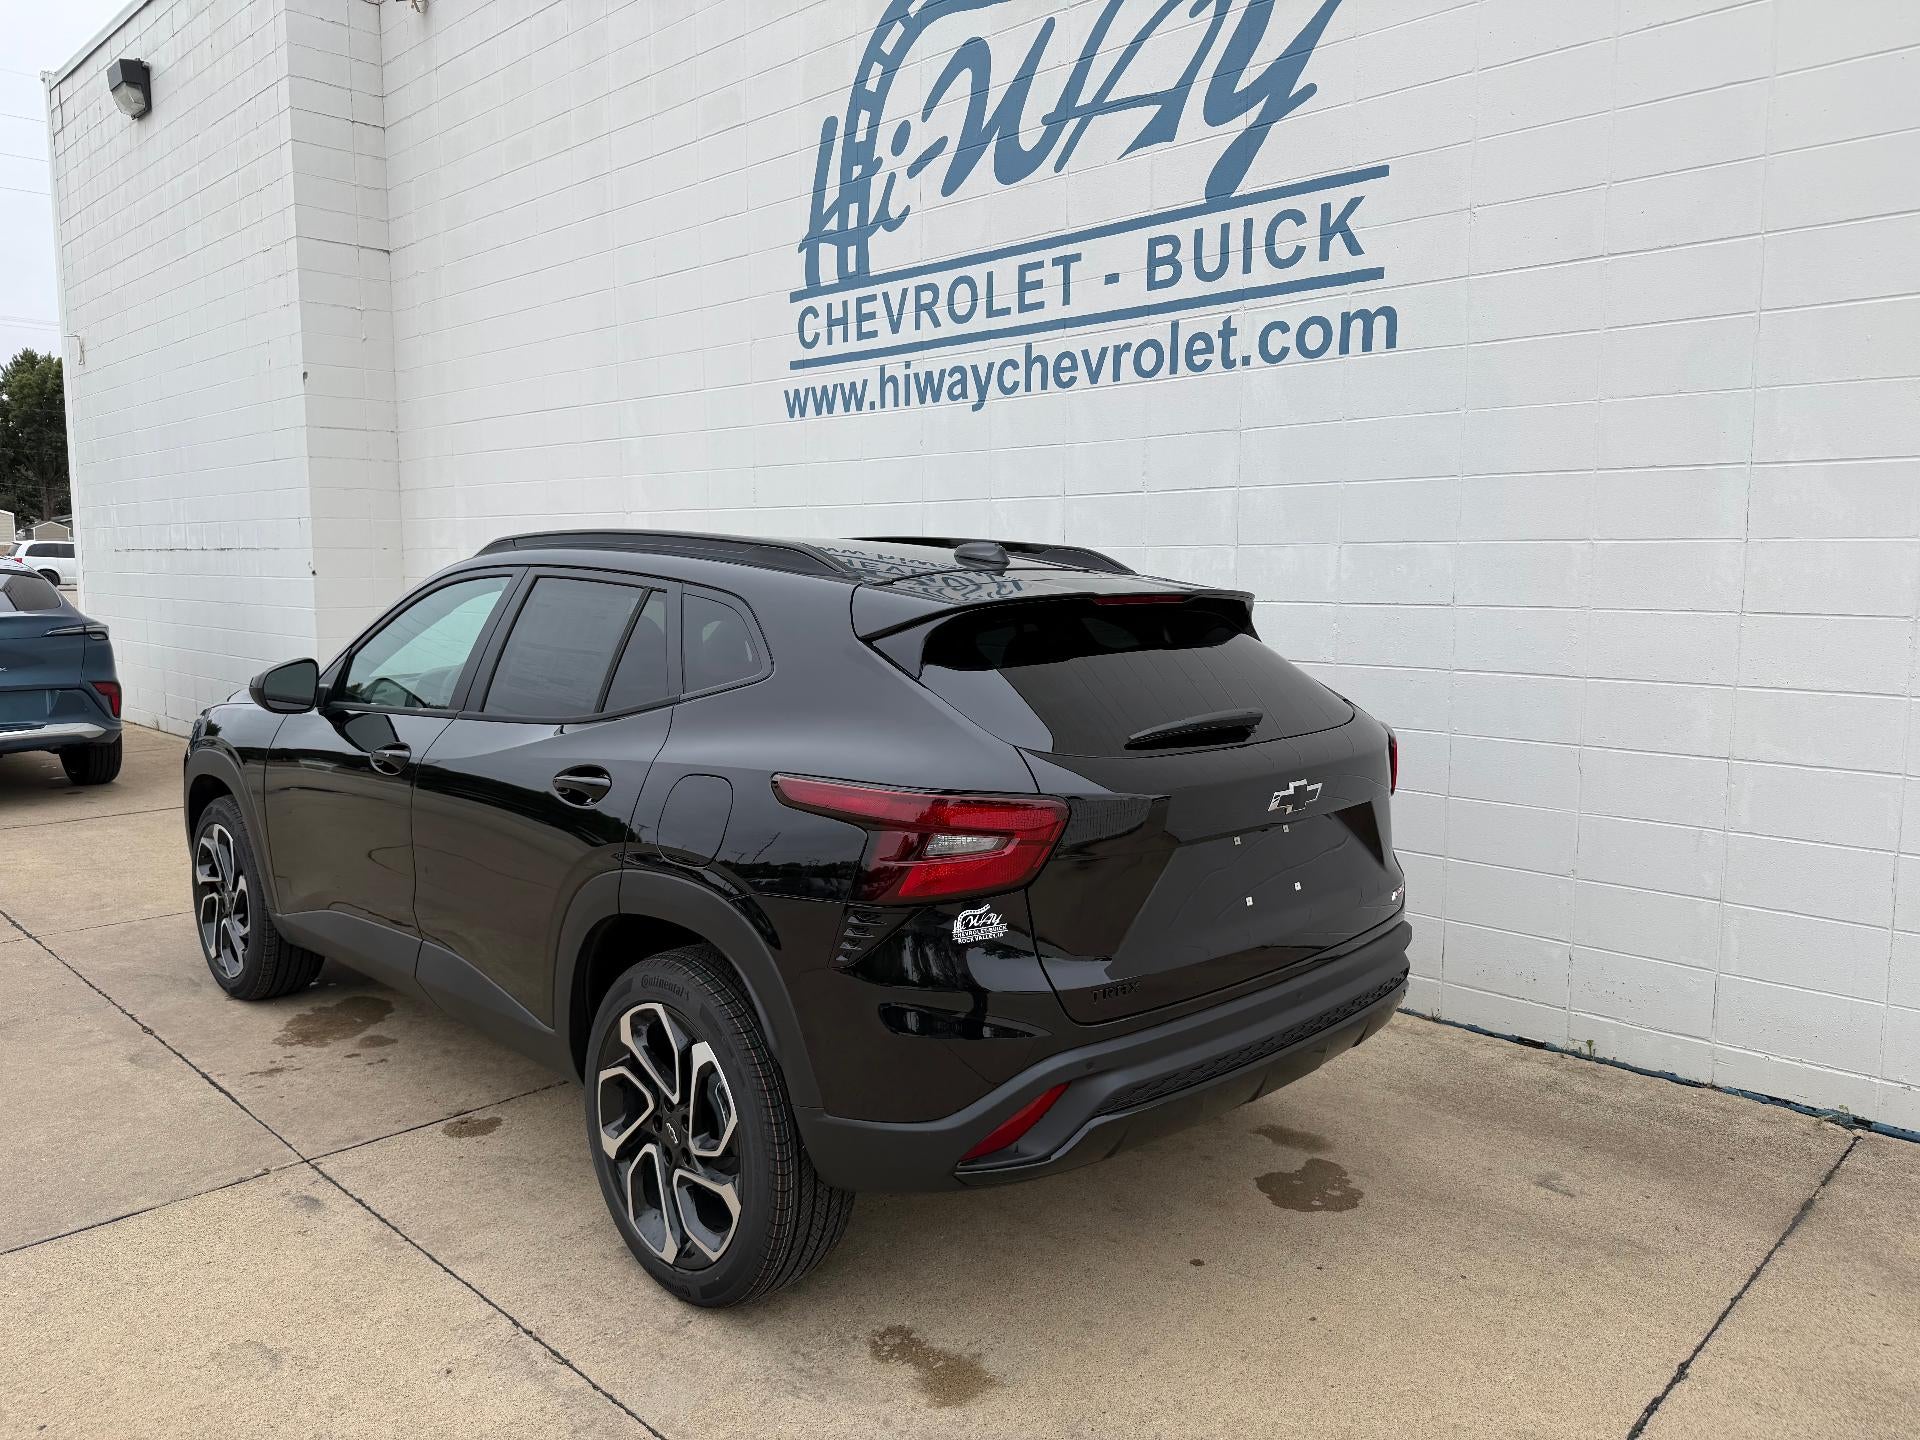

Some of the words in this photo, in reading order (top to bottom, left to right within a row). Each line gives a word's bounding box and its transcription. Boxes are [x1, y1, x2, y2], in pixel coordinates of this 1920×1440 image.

[798, 253, 1083, 350] CHEVROLET
[1147, 195, 1366, 291] BUICK
[784, 305, 1398, 419] www.hiwaychevrolet.com
